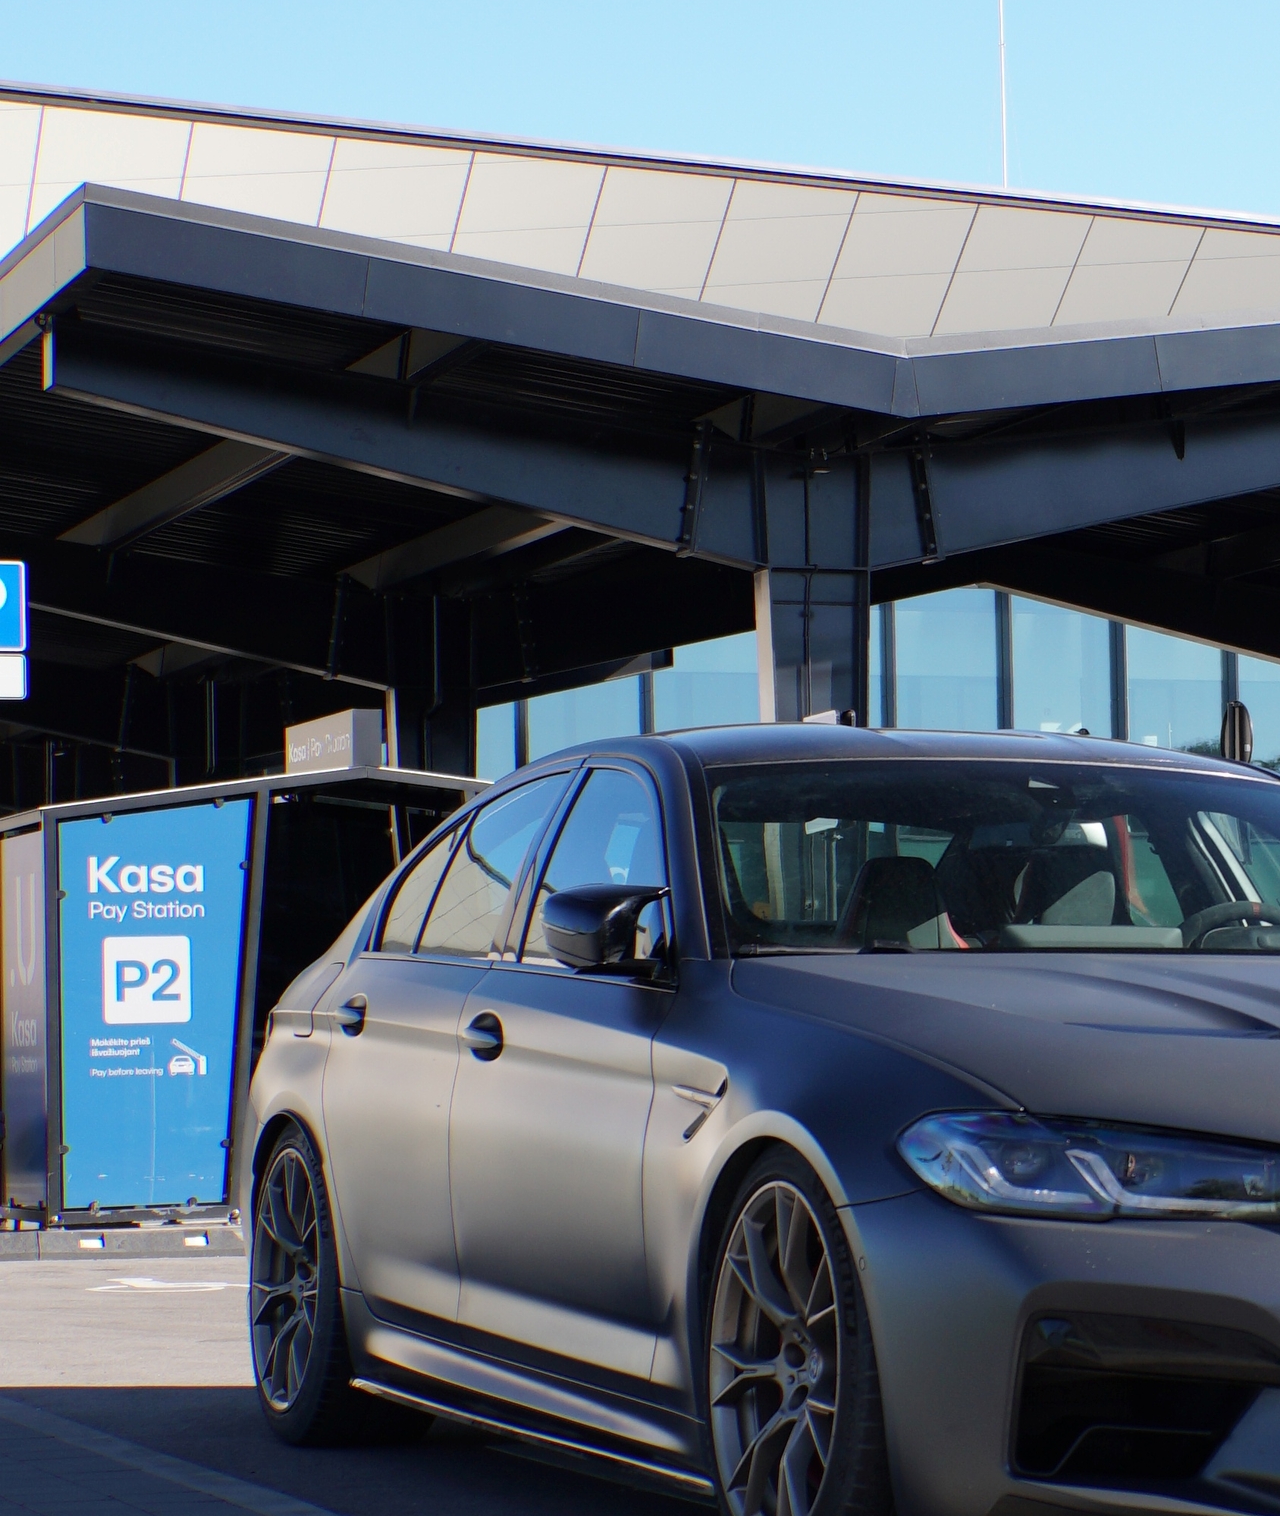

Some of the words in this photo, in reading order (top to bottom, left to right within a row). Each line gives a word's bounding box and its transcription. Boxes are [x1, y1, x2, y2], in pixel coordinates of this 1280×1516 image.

[288, 742, 307, 763] Kasa
[88, 855, 205, 894] Kasa
[90, 901, 128, 923] Pay
[132, 900, 206, 919] Station
[115, 958, 182, 1002] P2
[11, 1010, 38, 1048] Kasa
[92, 1068, 107, 1078] Pay
[108, 1067, 135, 1077] before
[135, 1067, 164, 1077] leaving
